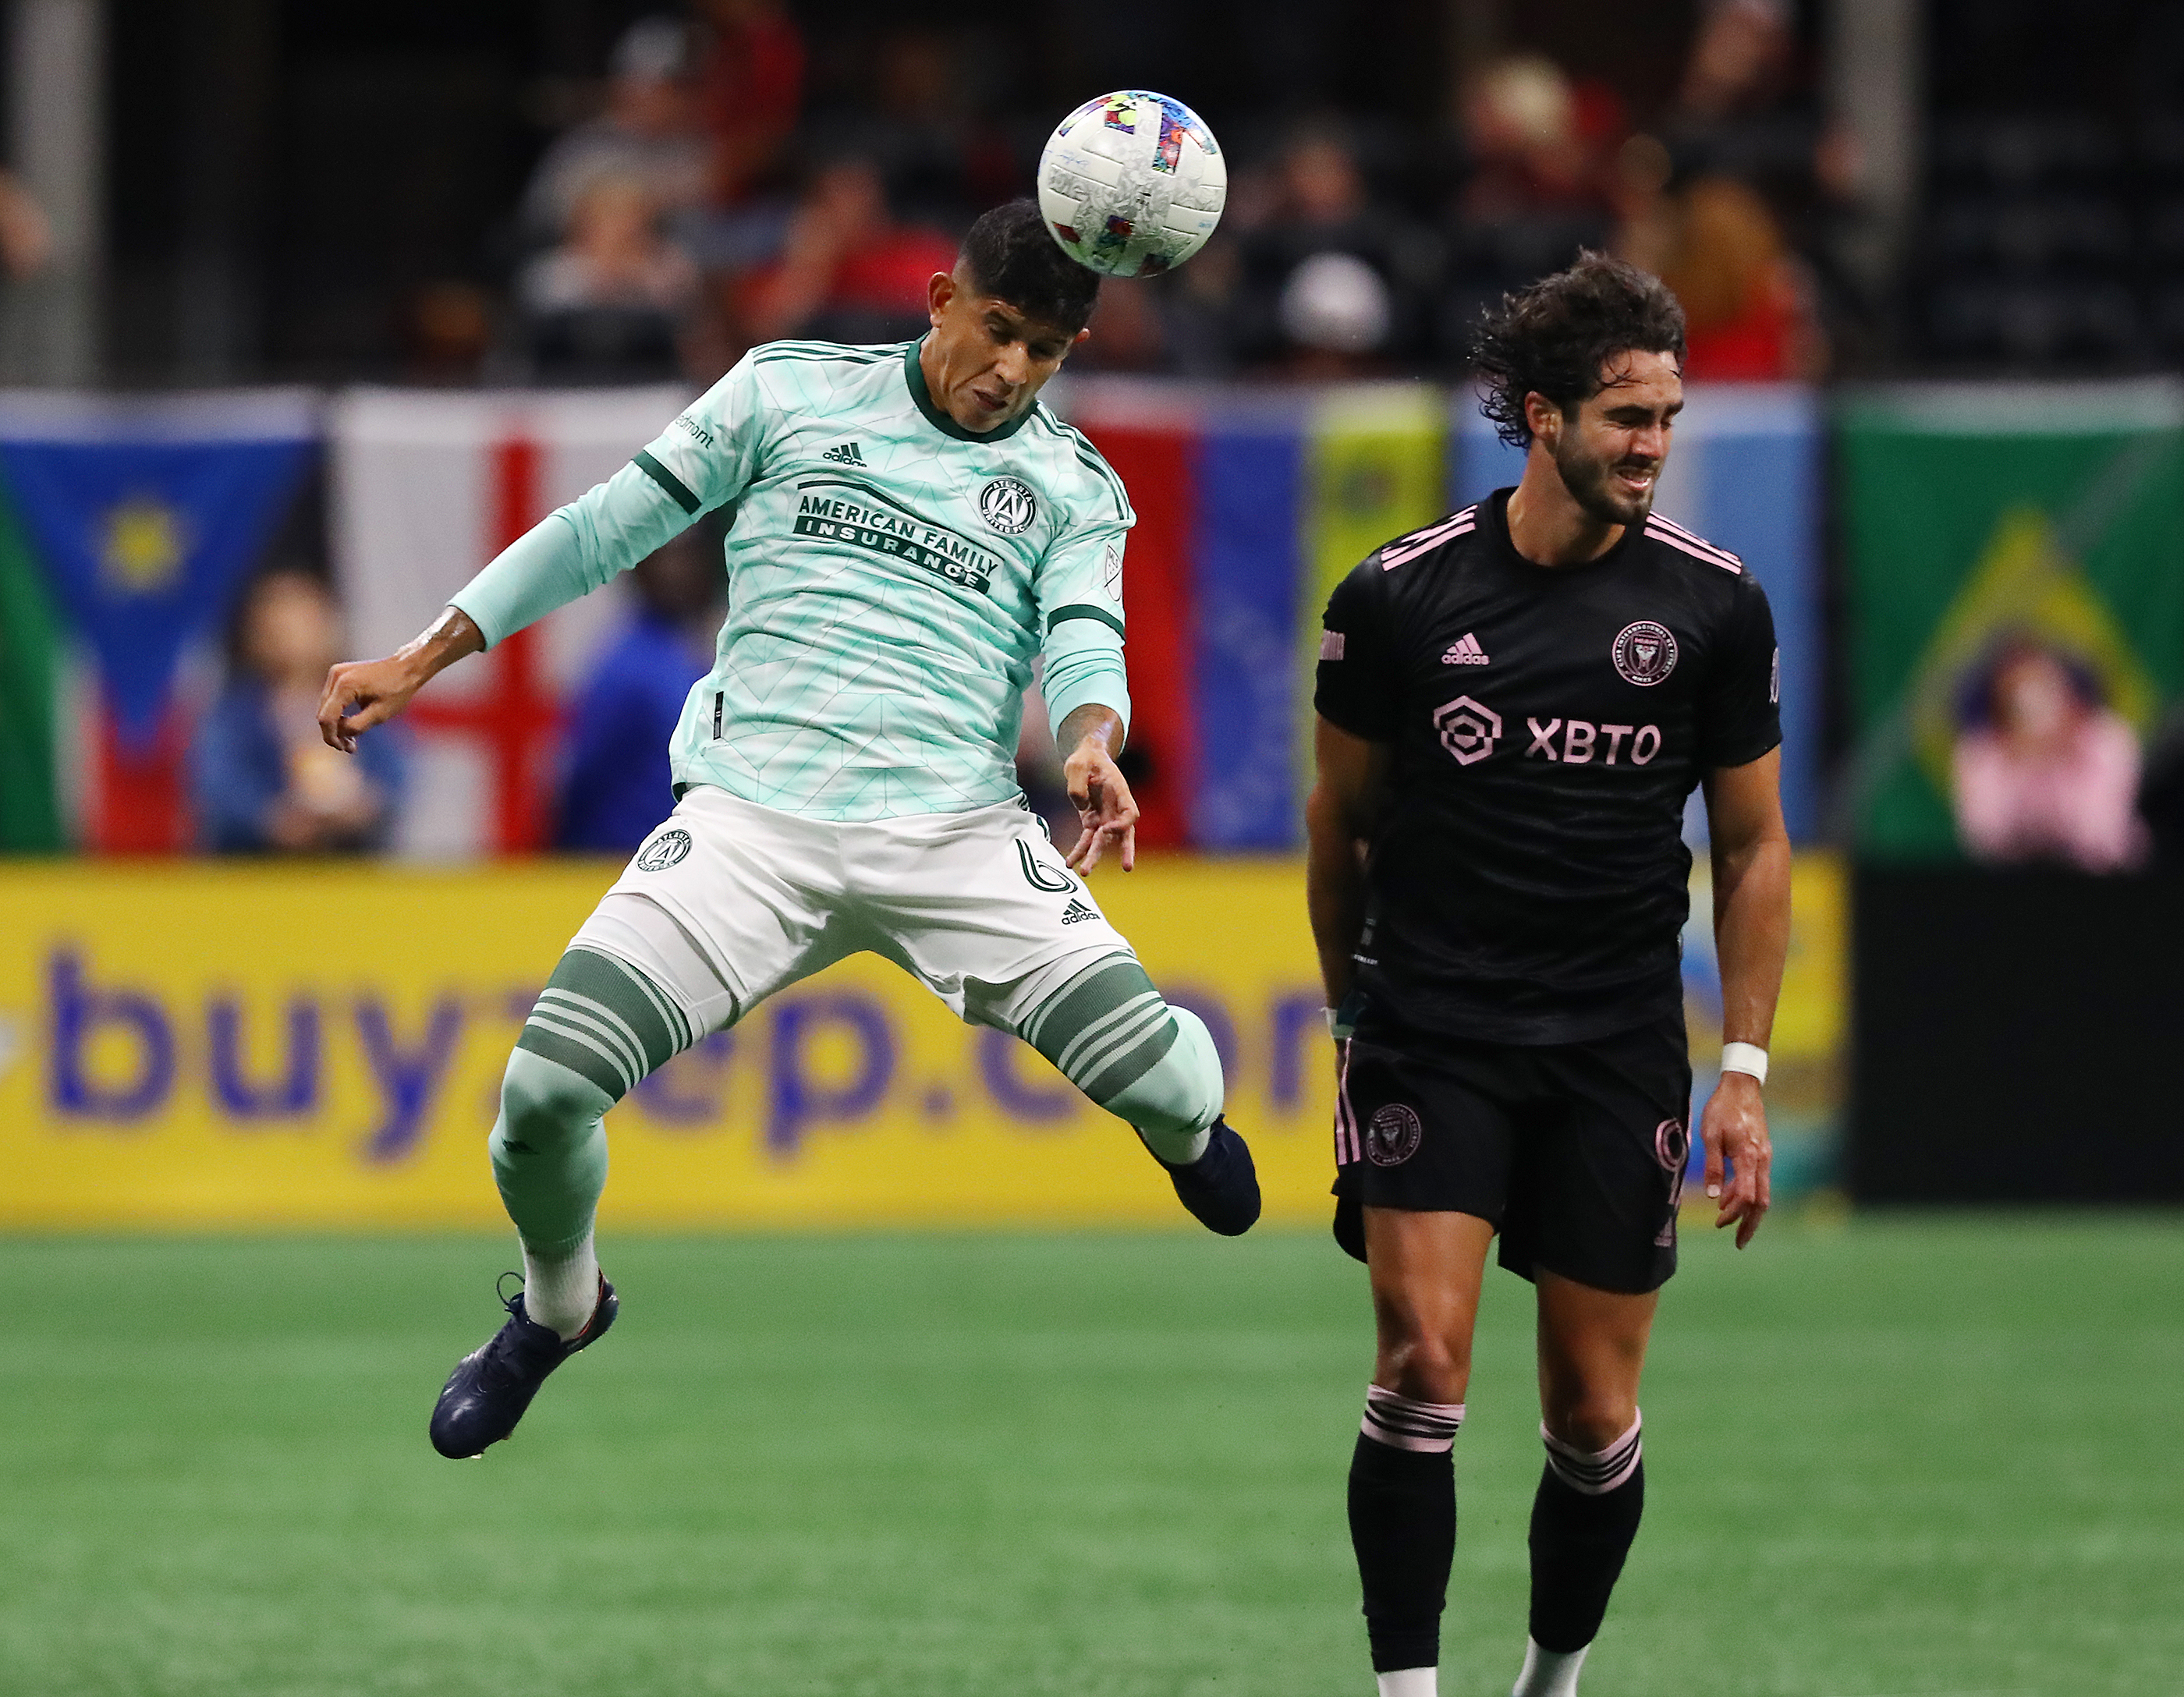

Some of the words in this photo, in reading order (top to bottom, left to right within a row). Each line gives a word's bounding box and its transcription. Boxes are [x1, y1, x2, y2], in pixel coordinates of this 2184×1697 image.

[992, 480, 1033, 503] ATLANTA
[799, 495, 916, 538] AMERICAN
[924, 530, 998, 578] FAMILY
[982, 508, 1011, 533] UNITED
[1012, 524, 1026, 534] FC
[805, 519, 980, 586] INSURANCE
[1441, 653, 1490, 666] adidas
[1524, 717, 1661, 766] XBTO
[1015, 838, 1078, 895] 6
[1655, 1118, 1688, 1210] 9
